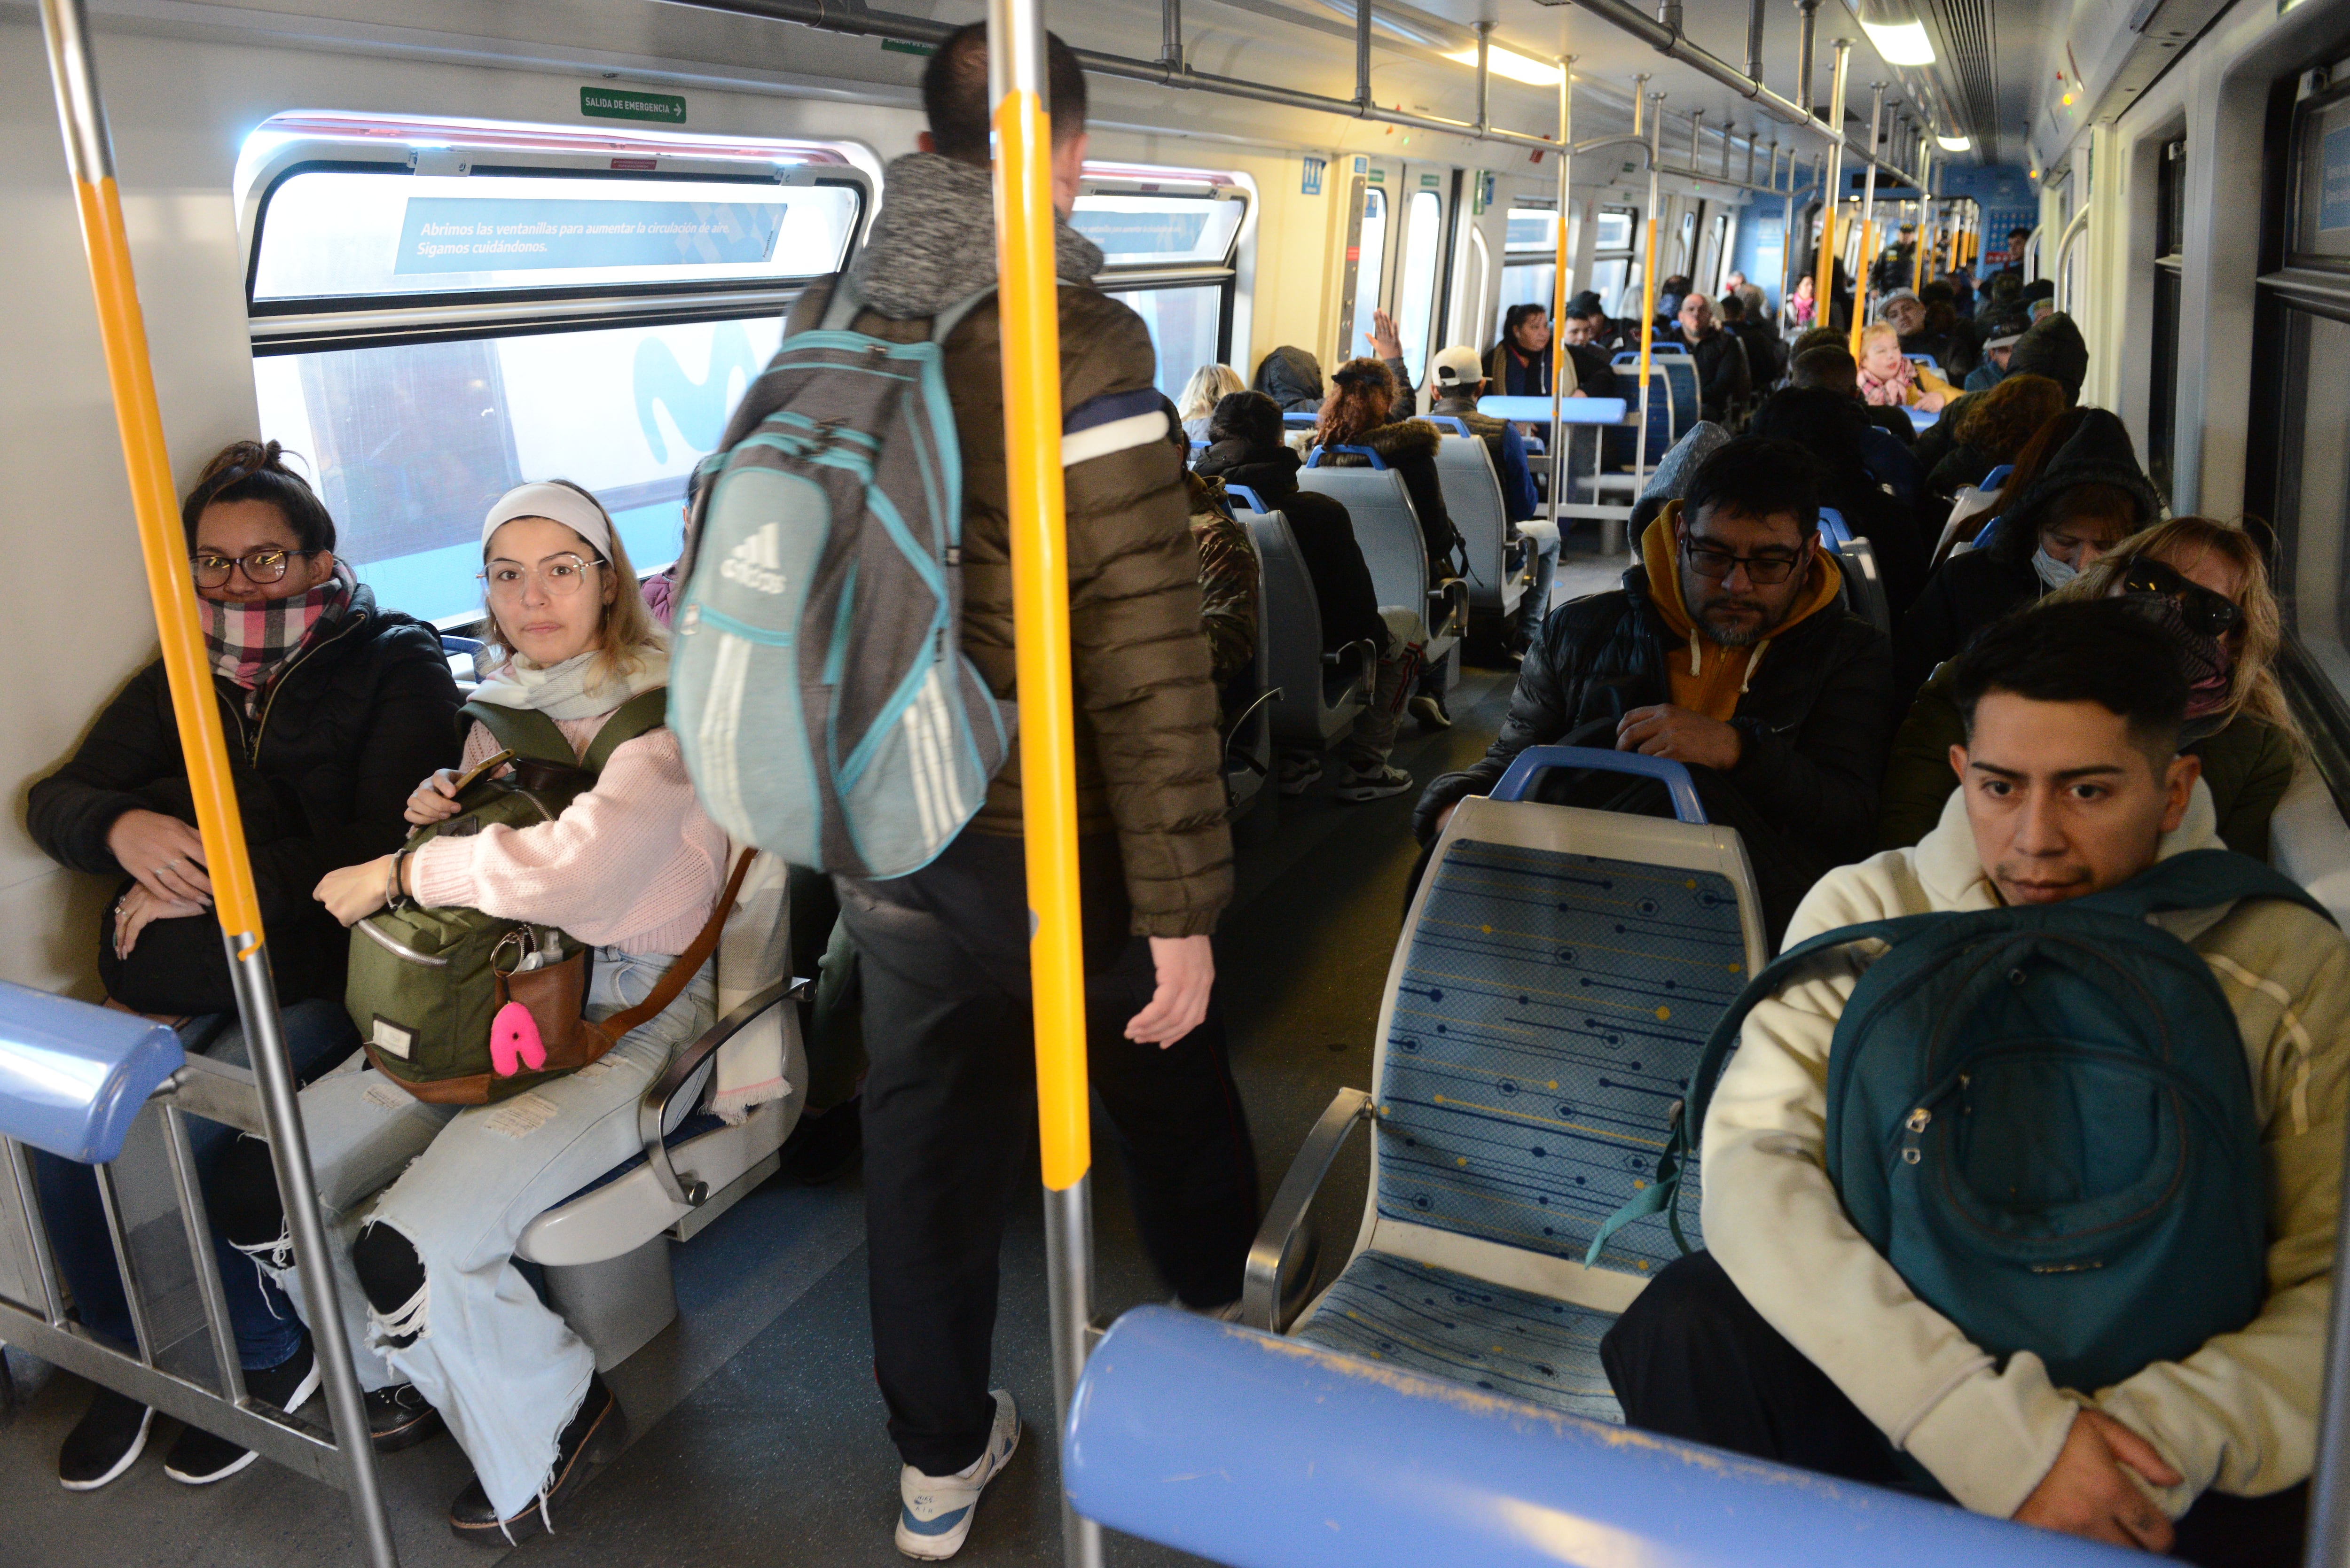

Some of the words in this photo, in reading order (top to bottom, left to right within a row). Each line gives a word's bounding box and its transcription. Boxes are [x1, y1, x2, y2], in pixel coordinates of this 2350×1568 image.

[586, 97, 612, 108] SALIDA
[613, 100, 624, 109] DE
[625, 101, 670, 113] EMERGENCIA
[421, 222, 474, 236] Abrimos
[476, 222, 494, 235] las
[496, 221, 557, 235] ventanillas
[558, 224, 584, 238] para
[586, 223, 635, 234] aumentar
[636, 221, 646, 234] la
[648, 221, 697, 234] circulación
[698, 221, 709, 234] de
[711, 222, 730, 234] aire.
[417, 242, 470, 257] Sigamos
[472, 239, 548, 254] cuidándonos.
[762, 230, 774, 258] Argentina
